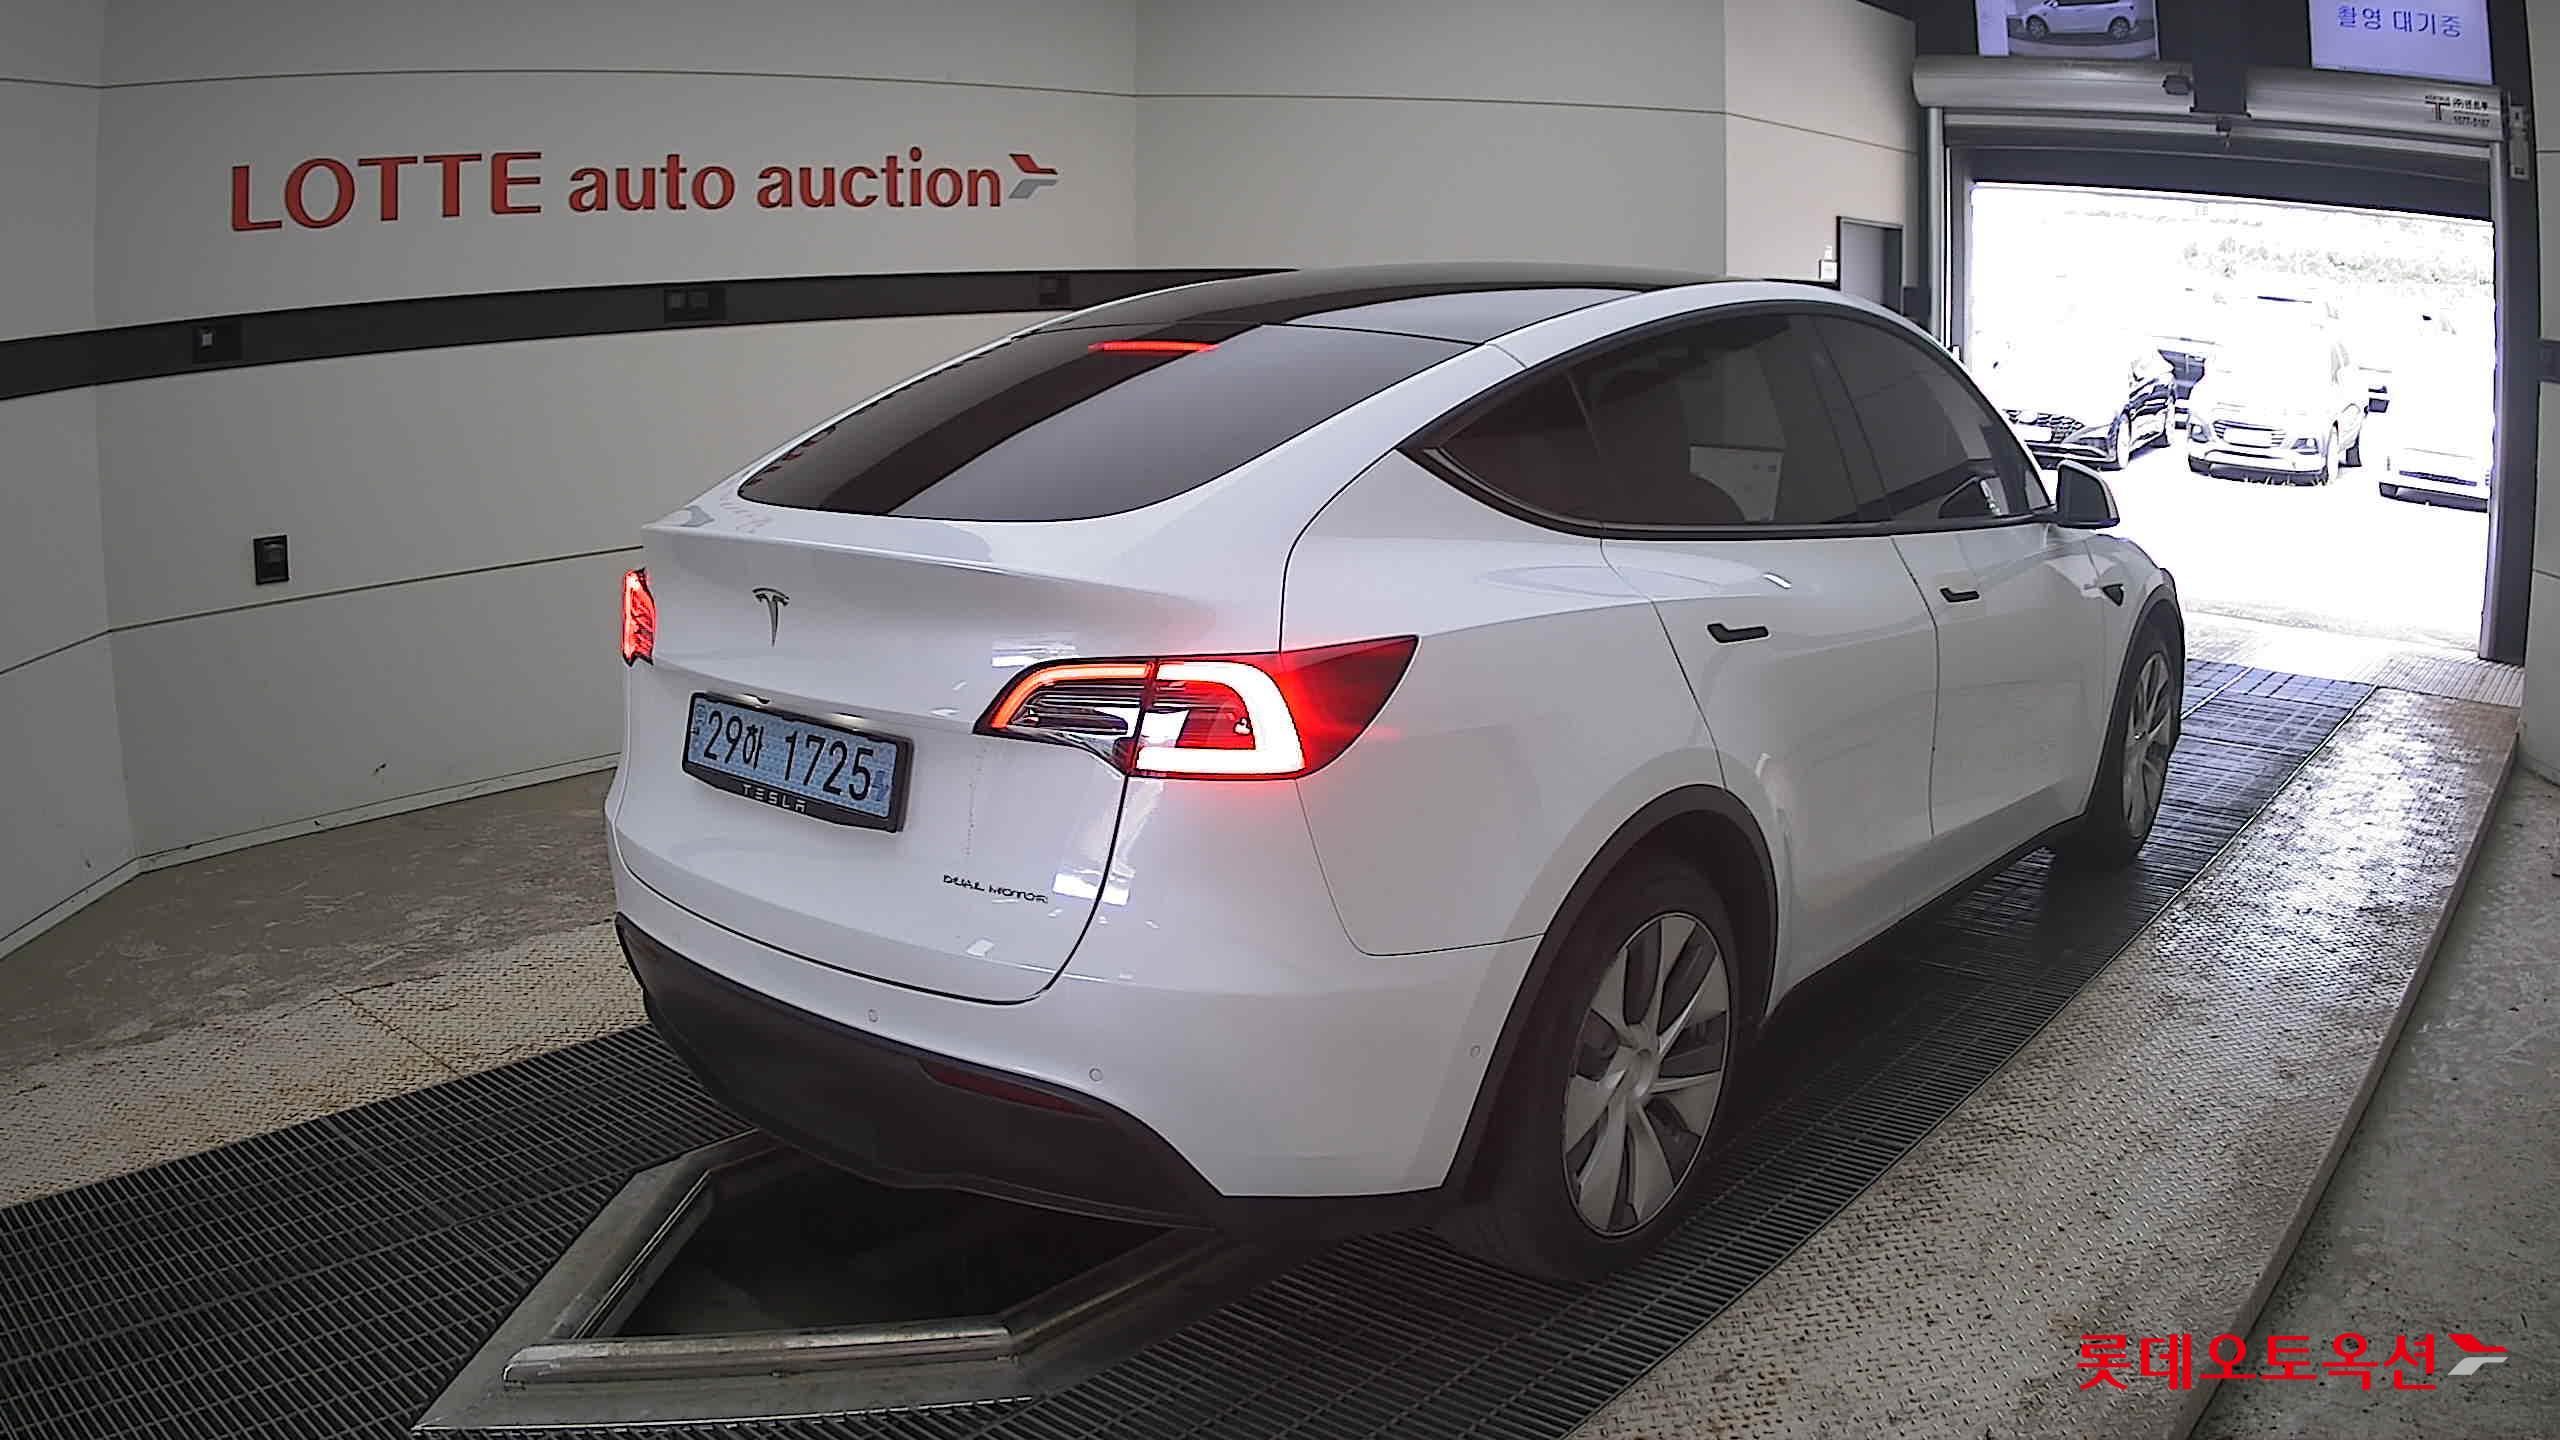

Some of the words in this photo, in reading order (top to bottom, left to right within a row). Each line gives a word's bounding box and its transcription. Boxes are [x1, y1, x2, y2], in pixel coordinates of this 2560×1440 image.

[2337, 5, 2382, 31] 촬영
[2393, 10, 2461, 38] 대기중
[231, 151, 542, 232] LOTTE
[568, 153, 736, 212] auto
[756, 146, 1002, 209] auction
[703, 709, 764, 771] 29하
[784, 730, 874, 802] 1725
[742, 783, 807, 816] TESLA
[943, 874, 985, 892] DUAL
[988, 884, 1048, 904] MOTOR
